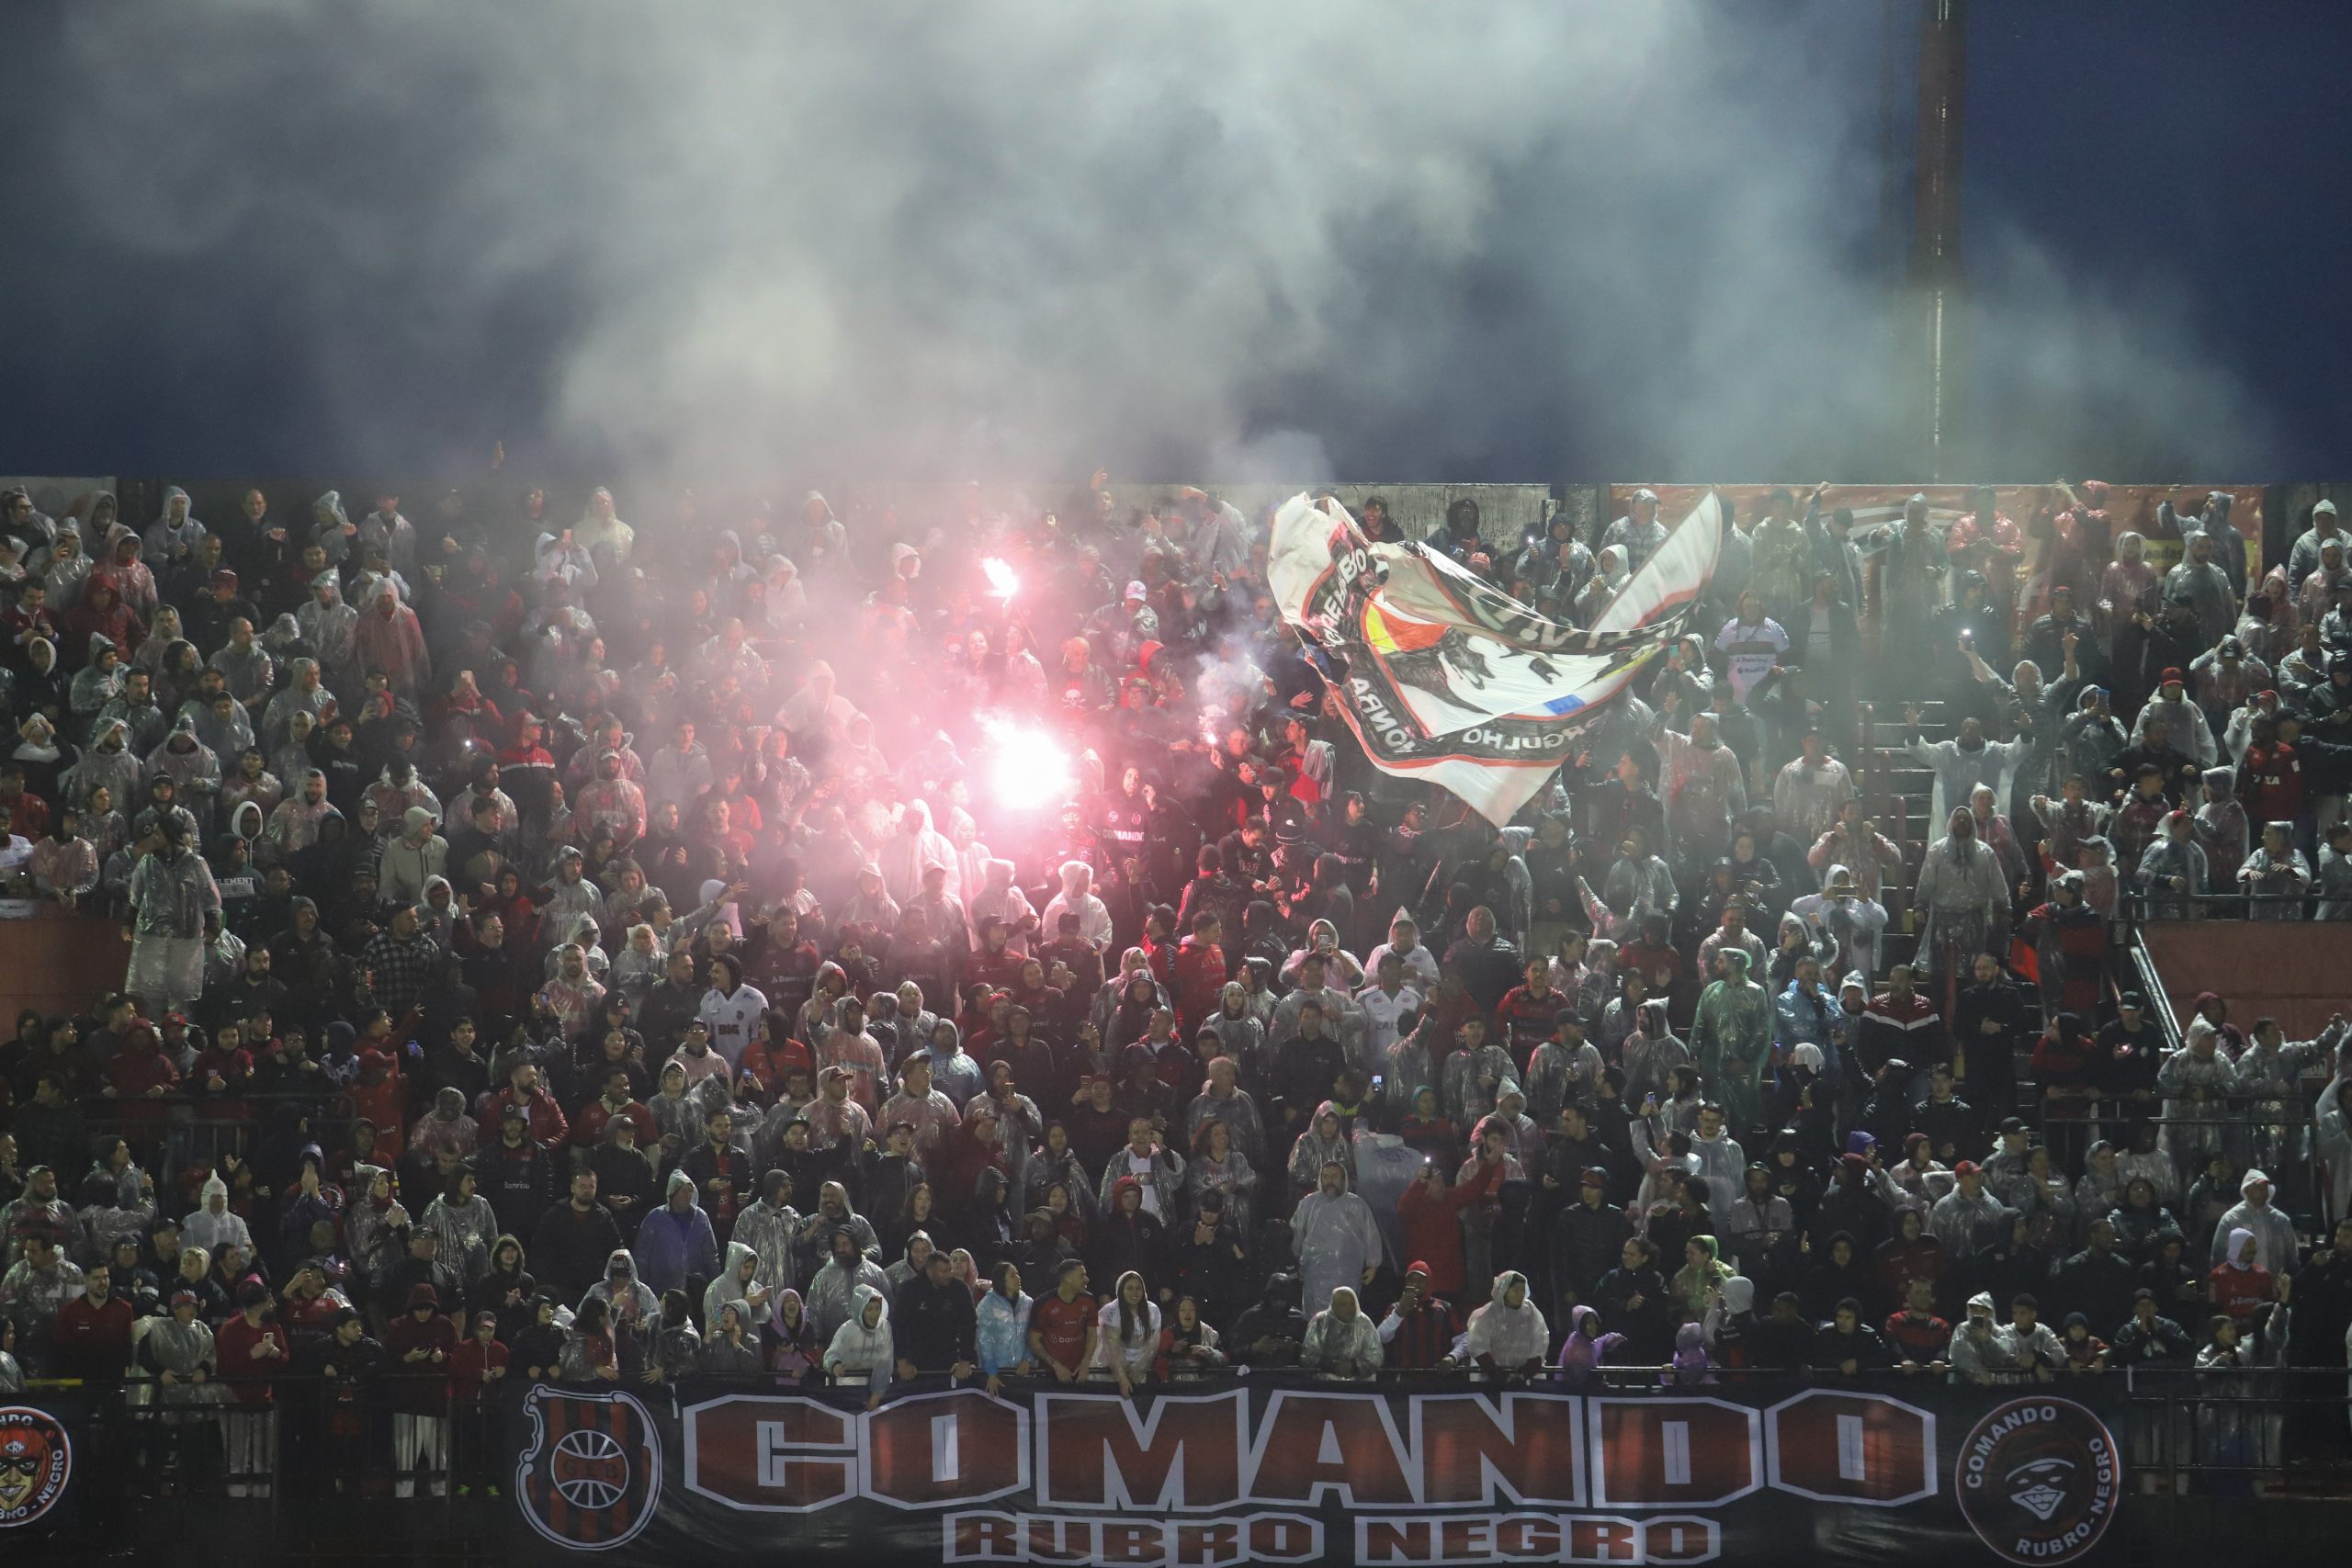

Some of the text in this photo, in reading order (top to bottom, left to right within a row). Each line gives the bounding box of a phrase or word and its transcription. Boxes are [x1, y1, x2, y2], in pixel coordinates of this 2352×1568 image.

[683, 1388, 1939, 1513] COMANDO
[1965, 1405, 2057, 1488] COMANDO
[944, 1511, 1721, 1567] RUBRO NEGRO
